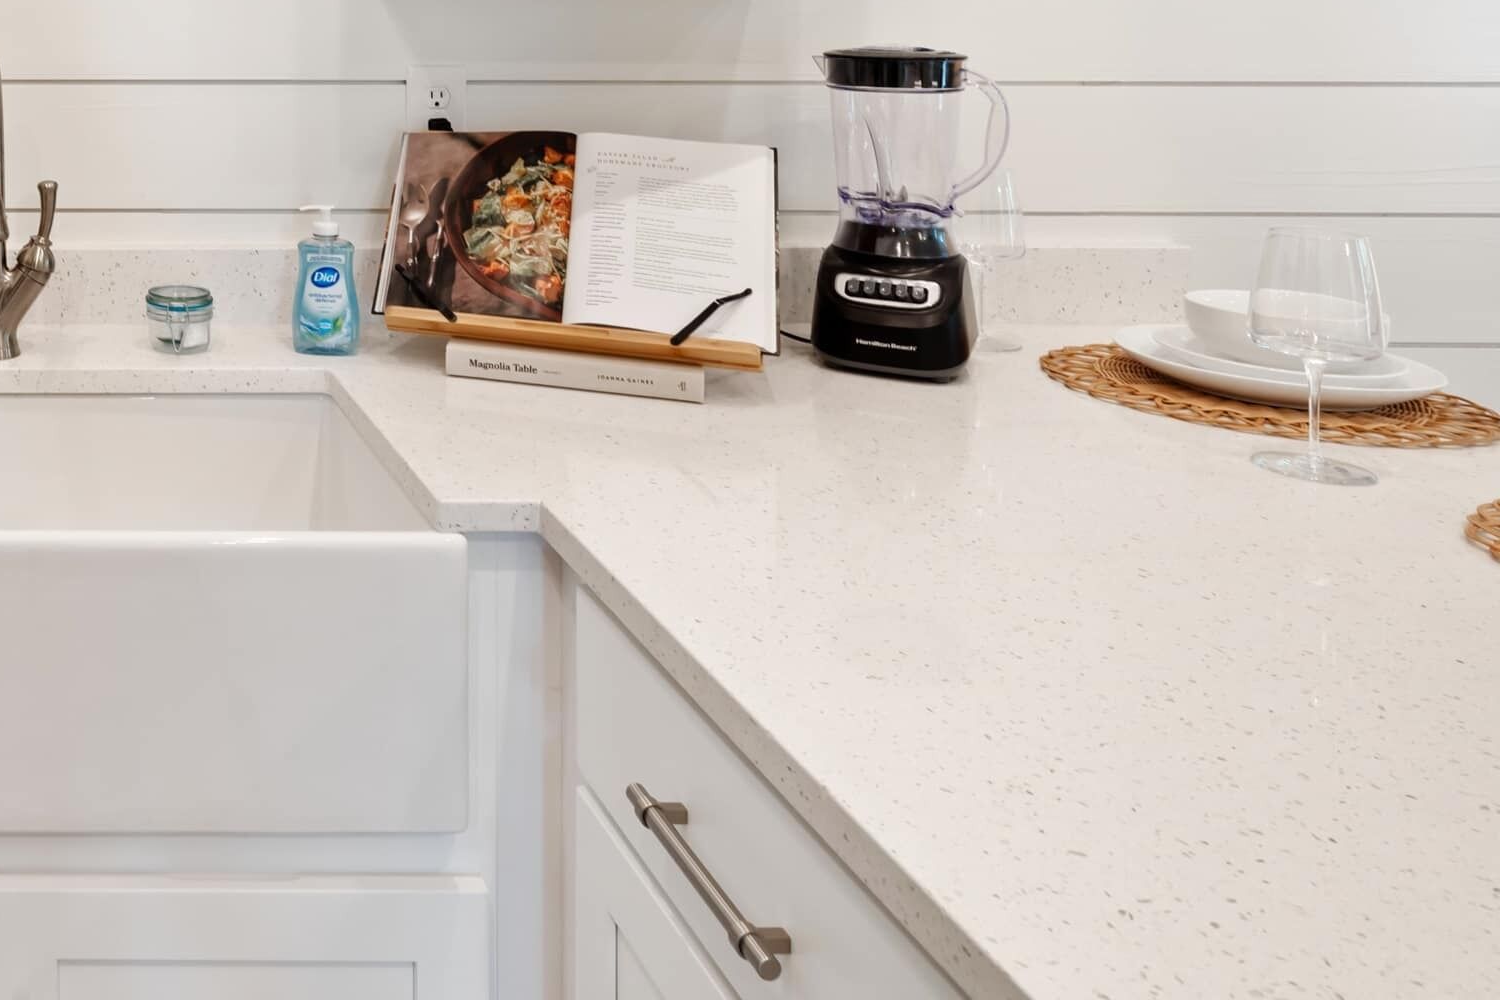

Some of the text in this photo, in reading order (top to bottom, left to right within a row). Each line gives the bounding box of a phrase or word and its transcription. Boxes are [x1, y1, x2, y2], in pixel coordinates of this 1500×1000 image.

[313, 271, 338, 283] Dial
[855, 337, 890, 348] Hamilton
[469, 358, 511, 372] Magnolia
[512, 363, 539, 375] Table
